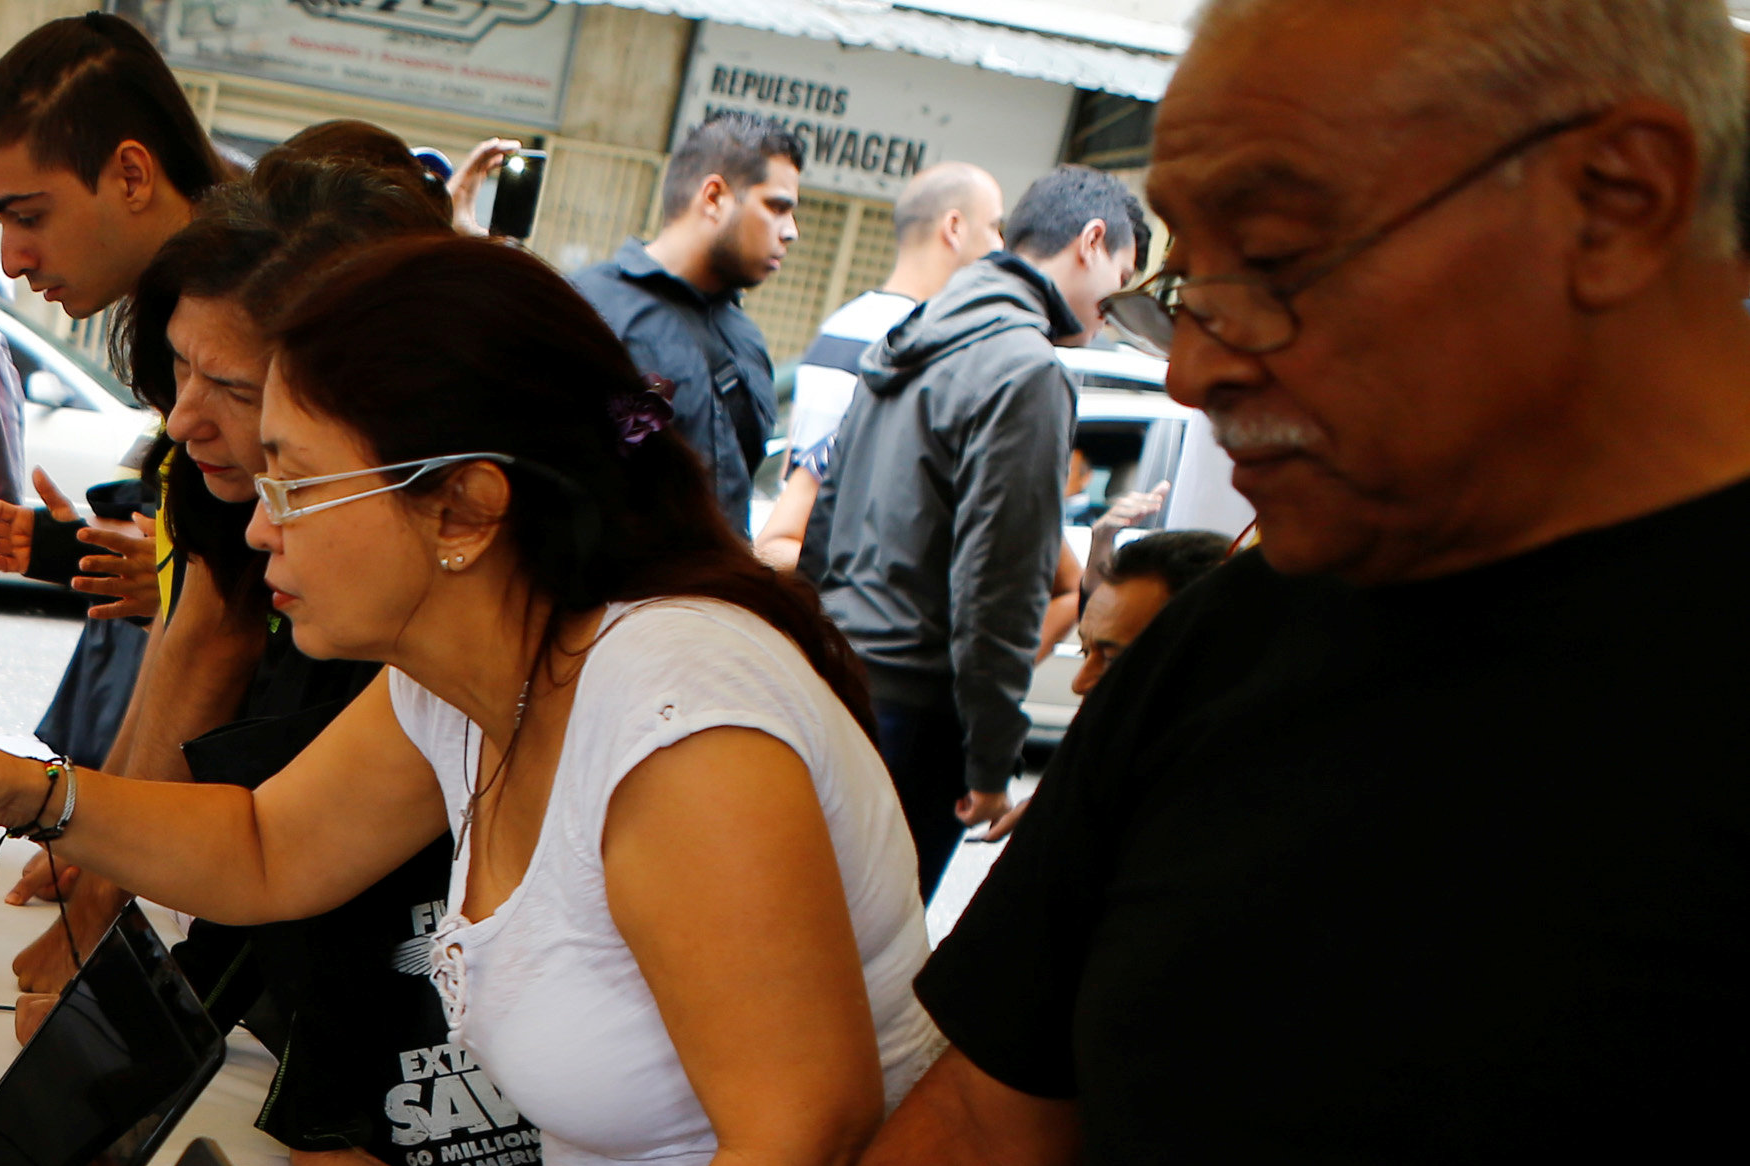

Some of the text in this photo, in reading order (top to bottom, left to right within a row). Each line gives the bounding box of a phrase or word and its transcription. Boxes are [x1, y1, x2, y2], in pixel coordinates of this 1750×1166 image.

[711, 65, 848, 116] REPUESTOS
[704, 103, 928, 177] SWAGEN
[399, 1043, 482, 1082] EXTA
[384, 1070, 520, 1146] SAV
[441, 1129, 541, 1163] MILLION
